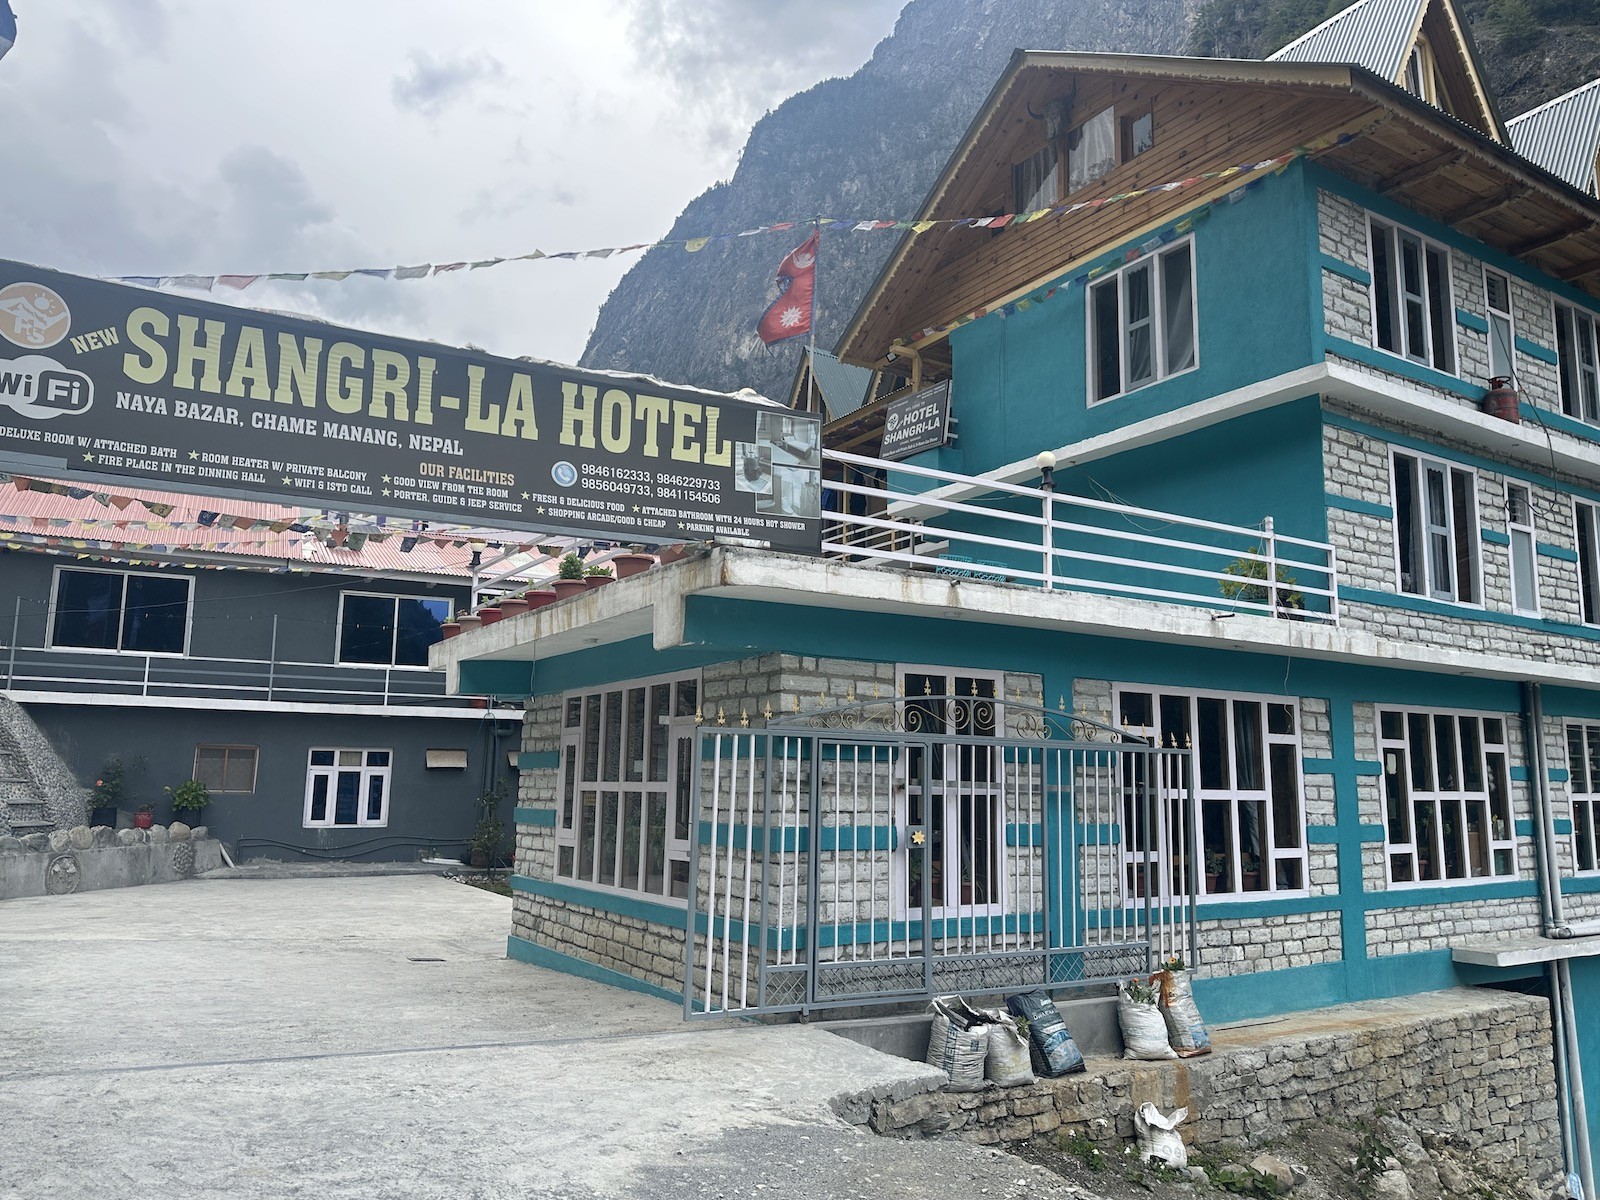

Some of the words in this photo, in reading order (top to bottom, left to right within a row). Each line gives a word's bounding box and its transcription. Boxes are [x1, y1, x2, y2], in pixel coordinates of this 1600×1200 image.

[70, 327, 119, 354] NEW
[123, 306, 539, 441] SHANGRI-LA
[559, 381, 731, 467] HOTEL
[116, 391, 167, 416] NAYA
[173, 400, 244, 428] BAZAR,
[251, 412, 317, 436] CHAME
[322, 422, 403, 449] MANANG,
[409, 434, 464, 456] NEPAL
[903, 402, 939, 426] HOTEL
[0, 425, 41, 441] DELUXE
[44, 432, 74, 446] ROOM
[78, 436, 91, 448] W/
[93, 439, 147, 455] ATTACHED
[150, 445, 177, 458] BATH
[883, 416, 941, 445] SHANGRI-LA
[98, 454, 123, 467] FIRE
[125, 458, 158, 471] PLACE
[161, 462, 172, 473] IN
[175, 464, 195, 475] THE
[198, 466, 239, 480] DINNING
[241, 472, 266, 483] HALL
[202, 452, 229, 465] ROOM
[232, 456, 269, 470] HEATER
[272, 461, 284, 472] W/
[286, 463, 325, 476] PRIVATE
[327, 468, 367, 481] BALCONY
[419, 462, 445, 477] OUR
[448, 466, 515, 486] FACILITIES
[581, 463, 653, 484] 9846162333,
[656, 473, 720, 490] 9846229733
[294, 478, 315, 489] WIFI
[318, 480, 324, 489] &
[327, 481, 348, 493] ISTD
[350, 484, 373, 495] CALL
[393, 476, 416, 487] GOOD
[418, 479, 440, 490] VIEW
[442, 482, 465, 493] FROM
[467, 485, 484, 496] THE
[486, 487, 509, 499] ROOM
[581, 477, 654, 498] 9856049733,
[656, 487, 720, 504] 9841154506
[432, 494, 458, 505] GUIDE
[460, 497, 466, 506] &
[468, 498, 487, 509] JEEP
[489, 501, 523, 512] SERVICE
[532, 493, 557, 504] FRESH
[560, 496, 565, 505] &
[567, 497, 605, 510] DELICIOUS
[606, 501, 625, 512] FOOD
[548, 507, 585, 520] SHOPPING
[637, 517, 642, 526] &
[643, 518, 666, 529] CHEAP
[641, 506, 677, 518] ATTACHED
[678, 510, 714, 522] BATHROOM
[715, 514, 732, 524] WITH
[733, 516, 742, 525] 24
[743, 517, 765, 527] HOURS
[765, 519, 779, 528] HOT
[780, 520, 806, 531] SHOWER
[686, 522, 714, 533] PARKING
[716, 526, 750, 537] AVAILABLE
